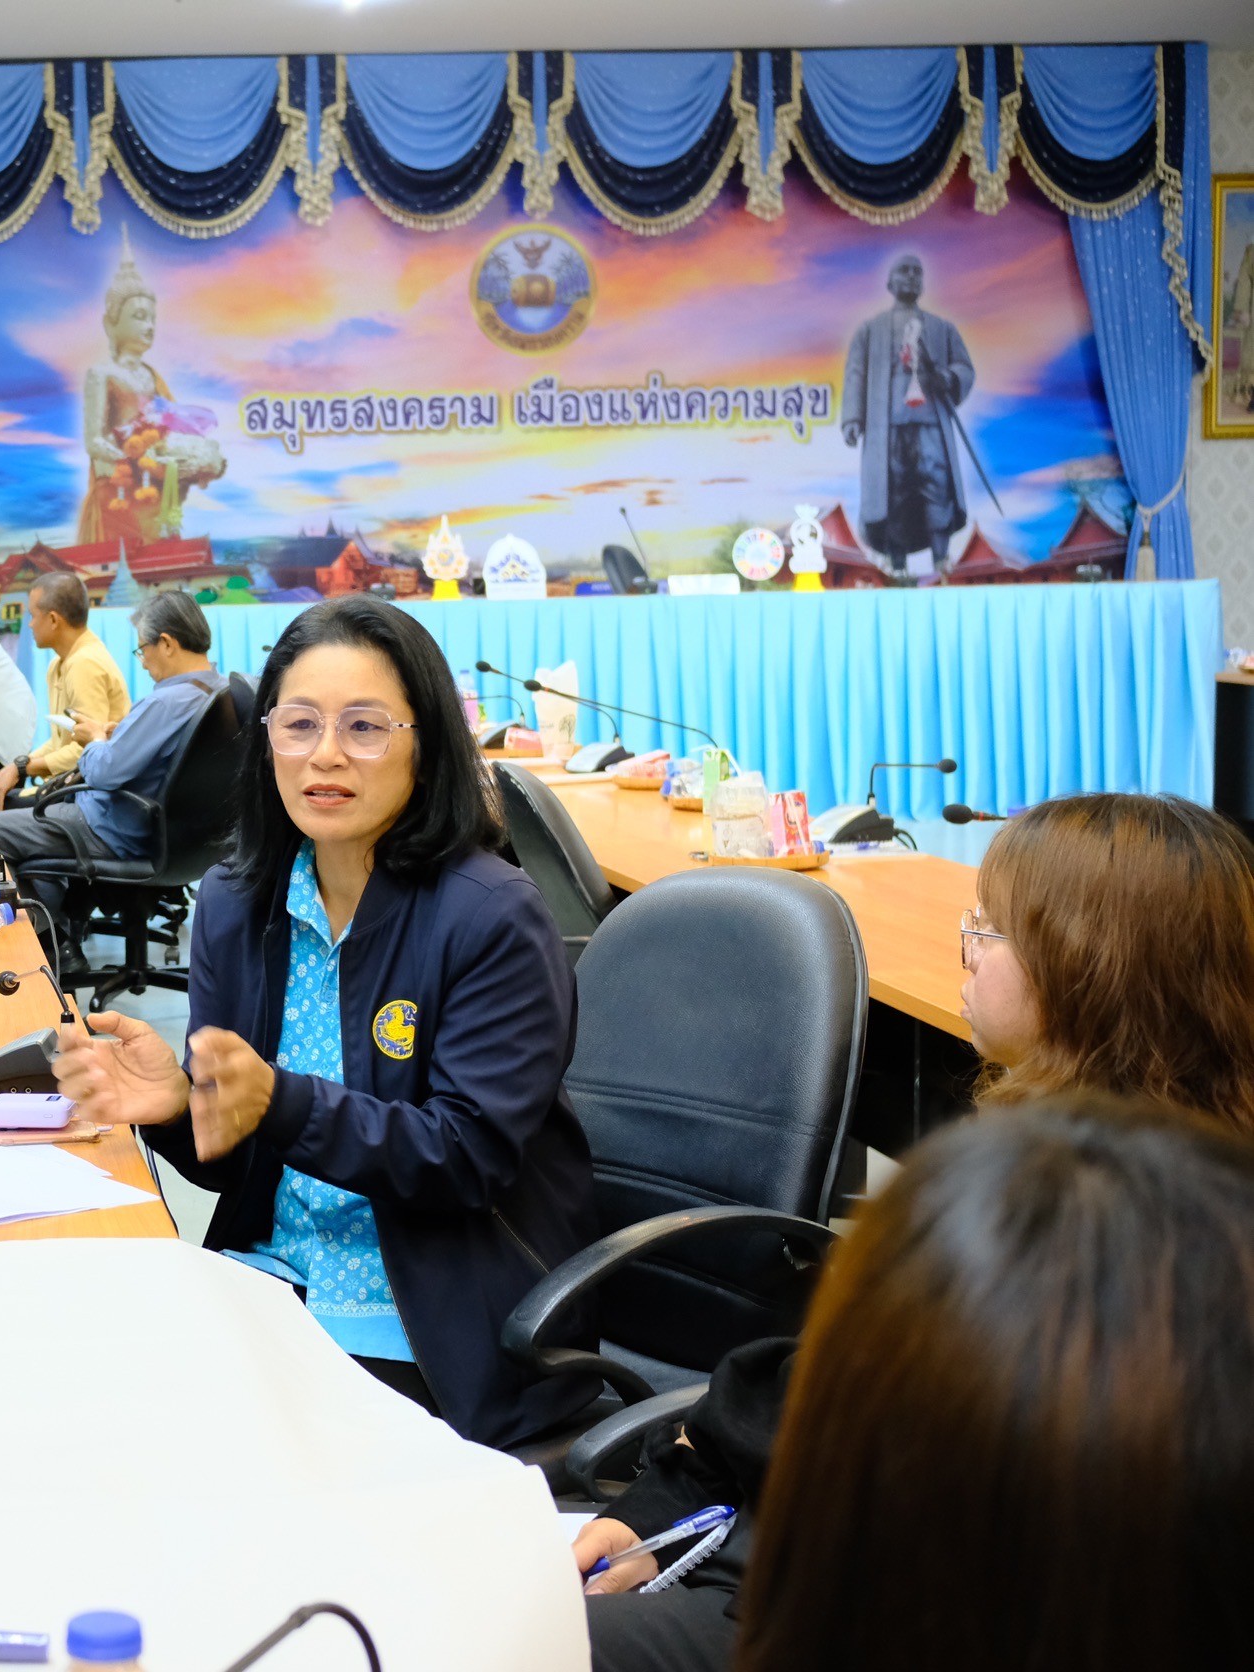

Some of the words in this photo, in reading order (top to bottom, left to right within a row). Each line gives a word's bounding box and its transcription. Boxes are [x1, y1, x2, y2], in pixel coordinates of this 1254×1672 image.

[245, 392, 496, 450] สมุทรสงคราม
[513, 375, 830, 441] เมืองแห่งความสุข
